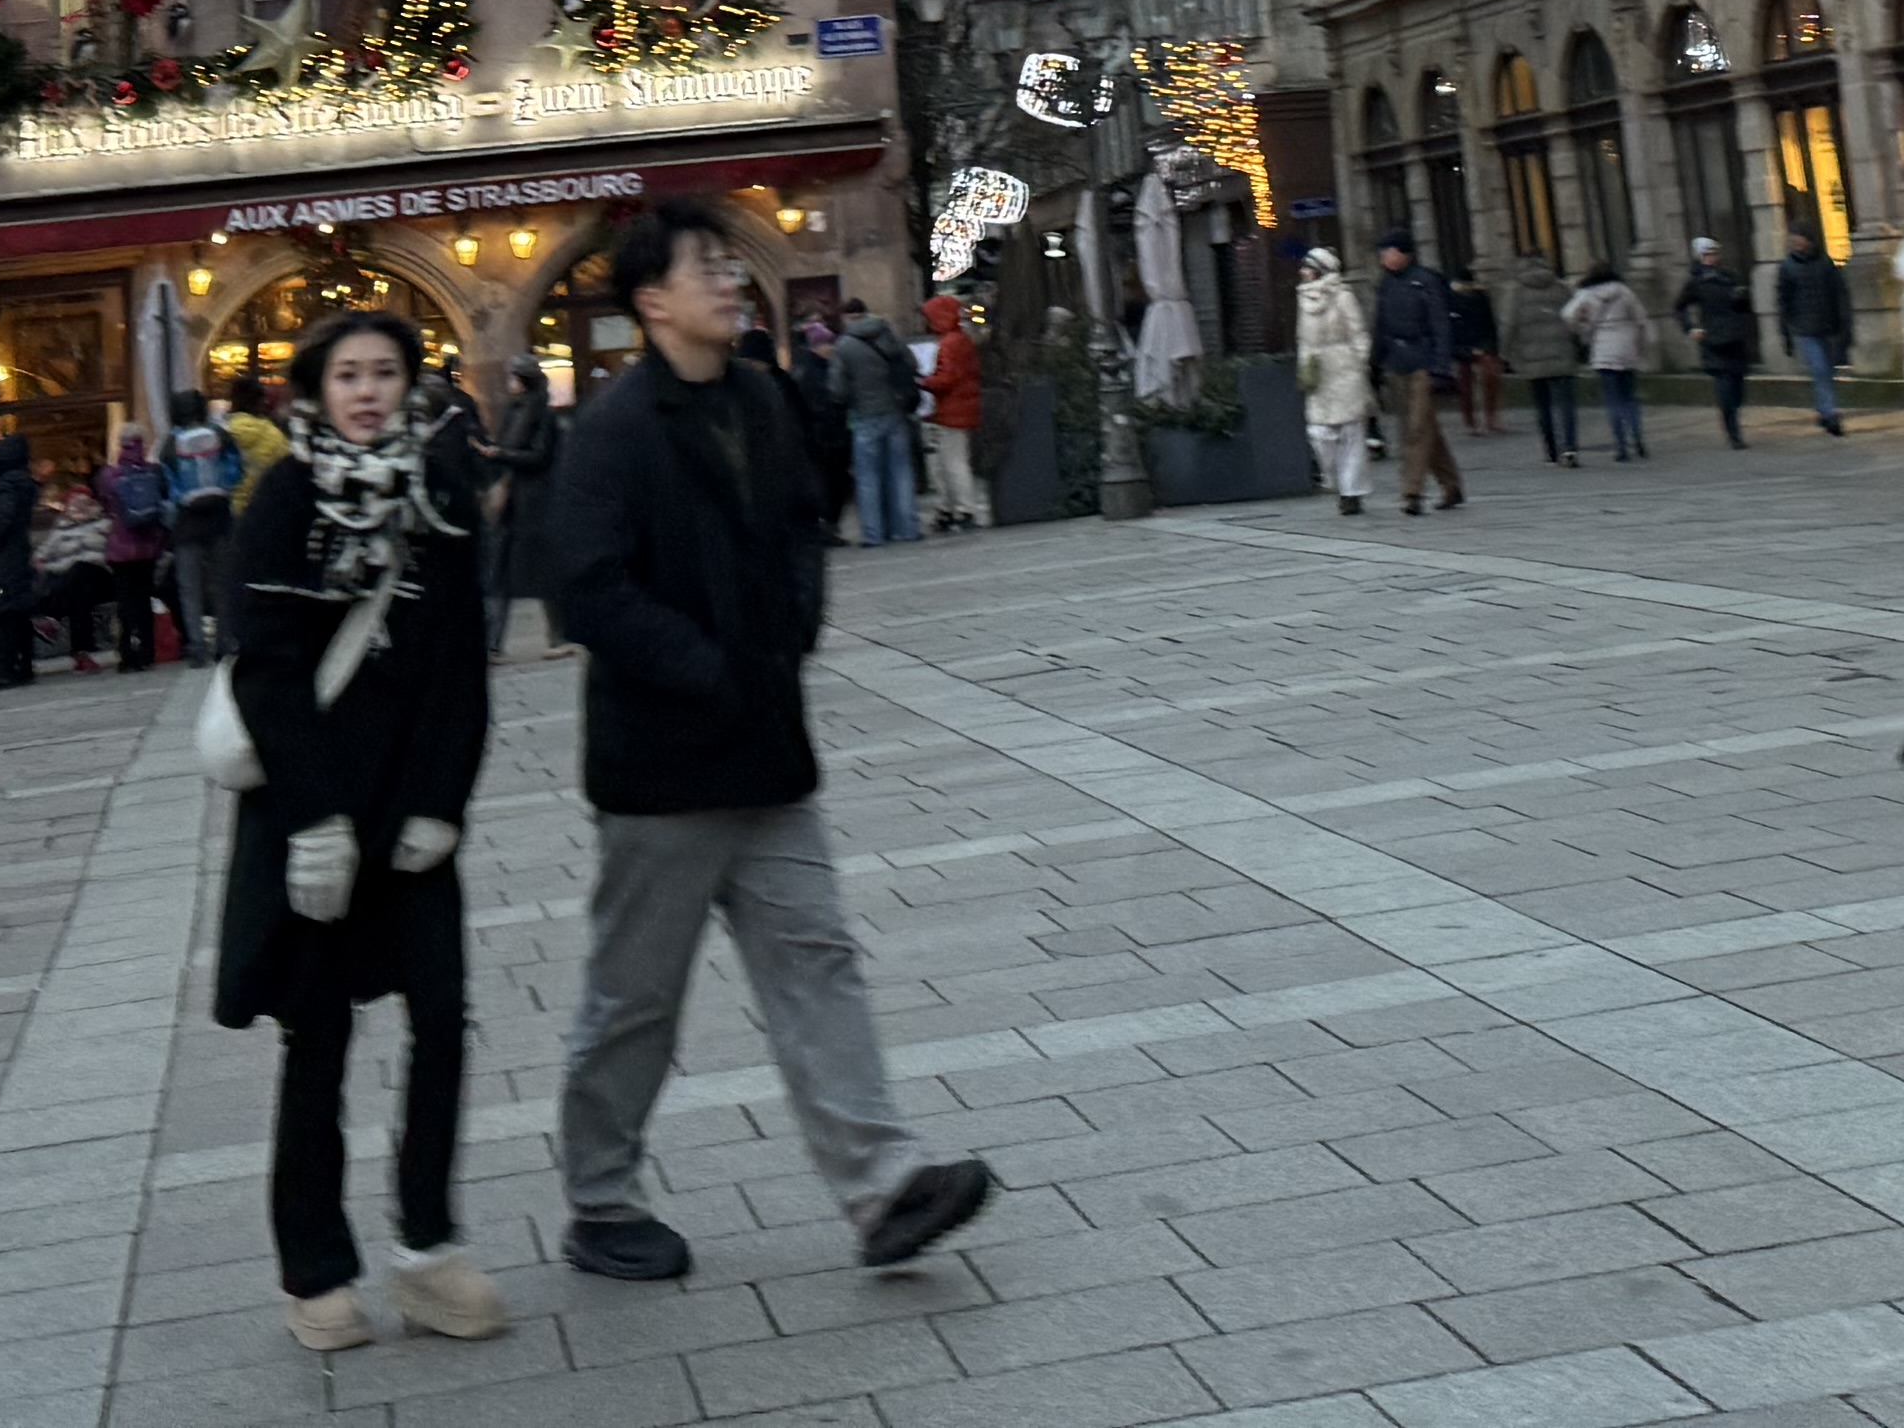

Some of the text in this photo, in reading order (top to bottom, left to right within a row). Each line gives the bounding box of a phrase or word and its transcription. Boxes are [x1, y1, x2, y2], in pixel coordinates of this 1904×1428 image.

[225, 172, 644, 232] AUX ARMES DE STRASBOURG
